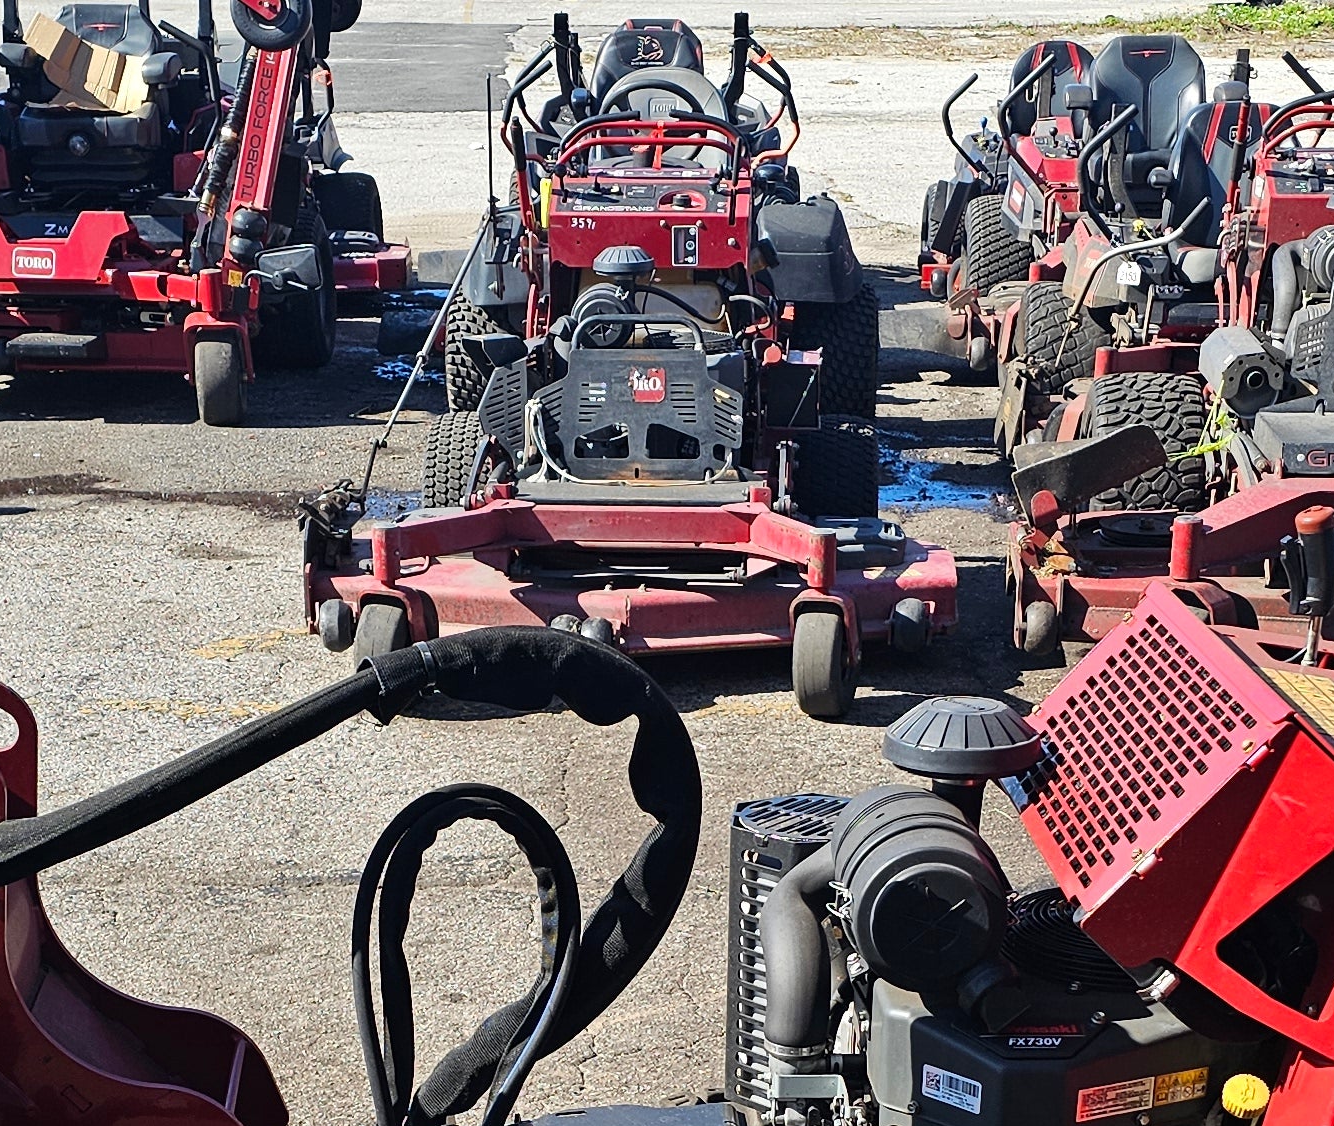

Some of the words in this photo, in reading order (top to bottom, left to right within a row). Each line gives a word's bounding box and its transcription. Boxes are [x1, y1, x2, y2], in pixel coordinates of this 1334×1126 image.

[240, 134, 262, 198] TURBO
[253, 66, 274, 130] FORCE
[16, 255, 53, 269] TORO
[1008, 1037, 1062, 1046] FX730V
